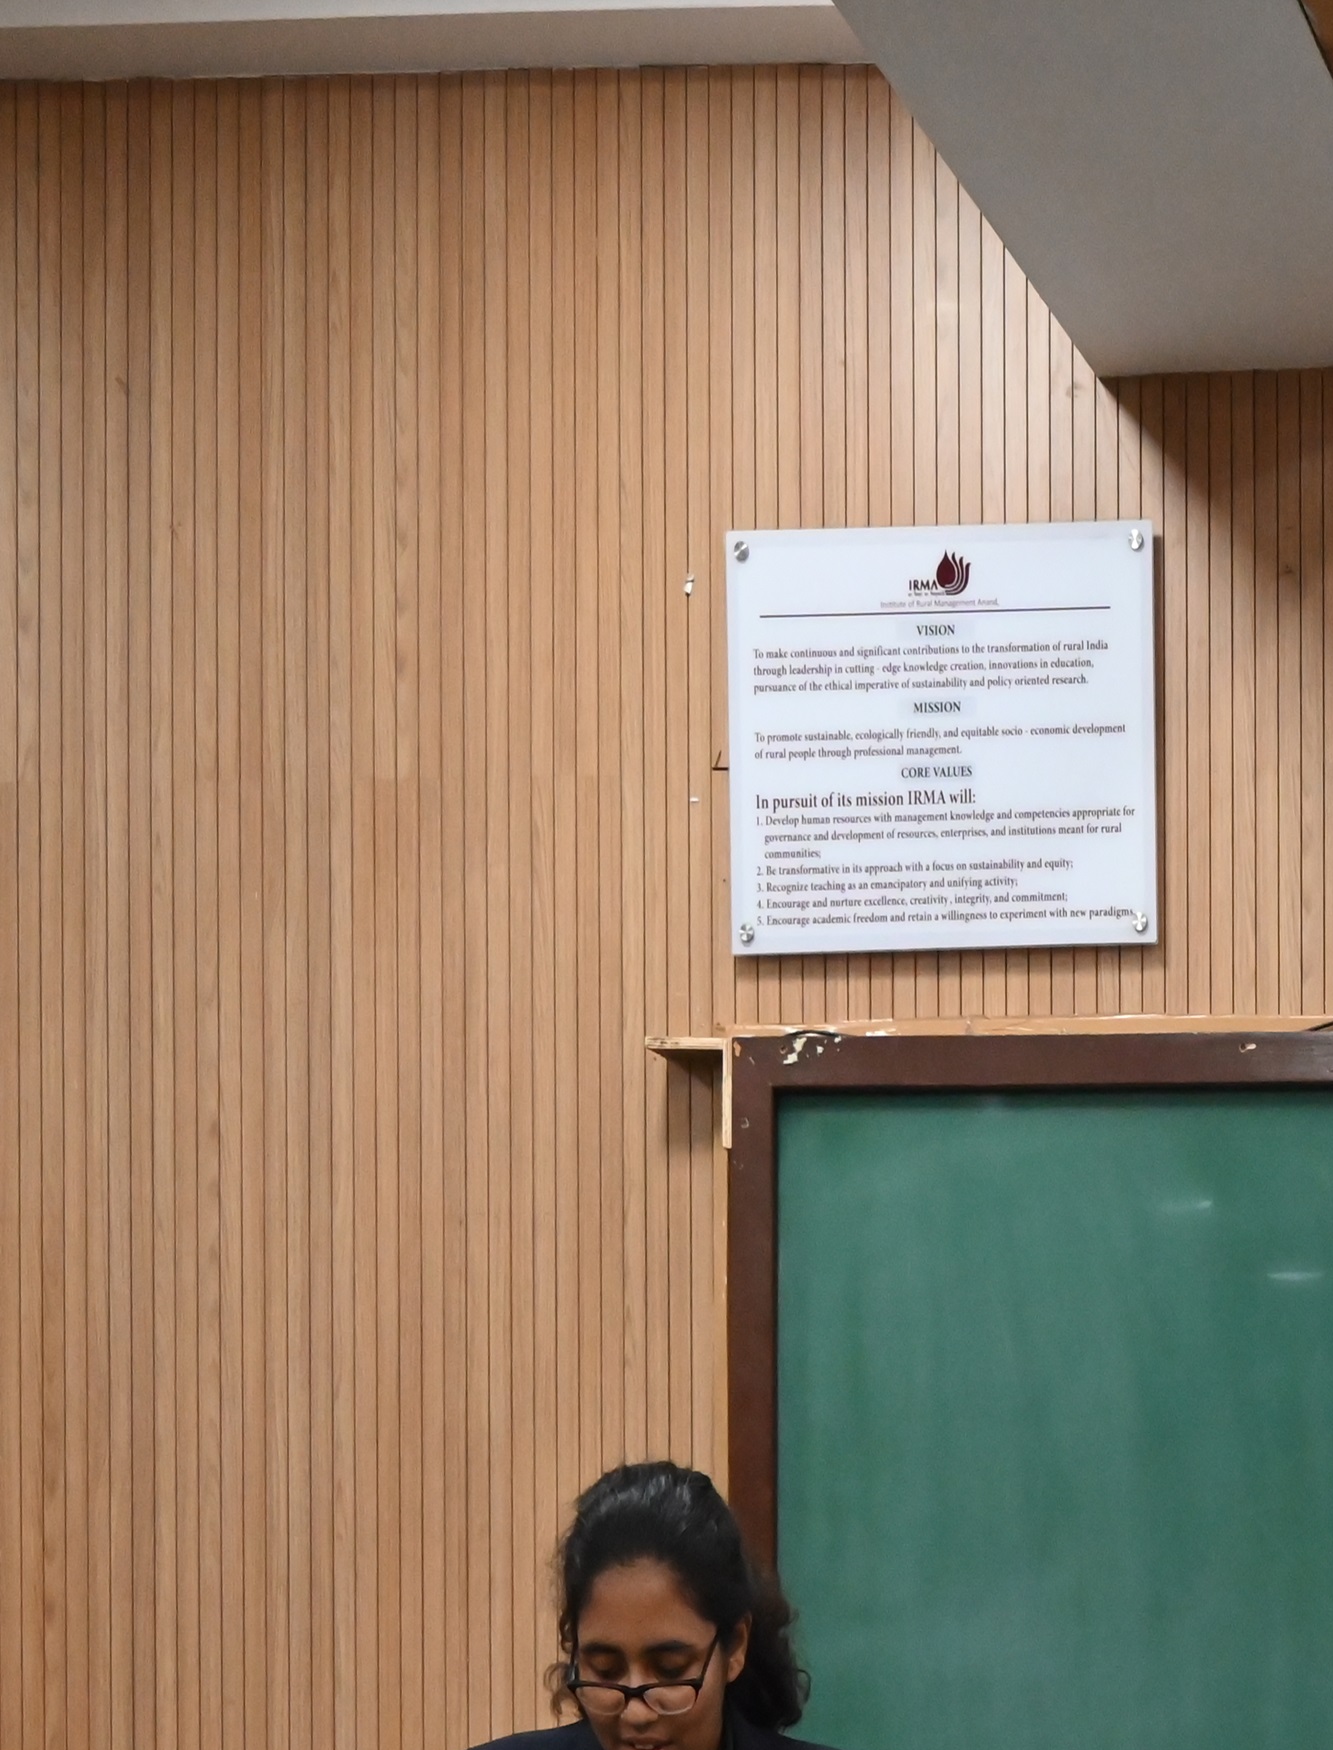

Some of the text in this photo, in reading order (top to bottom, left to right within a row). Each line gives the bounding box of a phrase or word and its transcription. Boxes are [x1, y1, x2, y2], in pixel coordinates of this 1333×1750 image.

[909, 580, 938, 591] IRMA
[916, 624, 954, 636] VISION
[753, 639, 1108, 659] To make continuous and significant contributions to the transformation of rural India
[753, 684, 796, 695] pursuance
[798, 681, 807, 690] of
[809, 681, 822, 690] the
[824, 679, 852, 690] ethical
[854, 679, 898, 692] imperative
[901, 678, 909, 688] of
[911, 676, 966, 689] sustainability
[969, 676, 984, 686] and
[987, 675, 1011, 689] policy
[1014, 674, 1049, 685] oriented
[914, 701, 961, 713] MISSION
[755, 732, 765, 742] To
[767, 733, 802, 745] promote
[855, 728, 902, 742] ecologically
[943, 727, 958, 737] and
[961, 726, 998, 739] equitable
[1001, 726, 1022, 735] socio
[1030, 725, 1069, 735] economic
[1072, 722, 1125, 736] development
[754, 749, 763, 758] of
[765, 748, 786, 758] rural
[788, 747, 815, 761] people
[818, 746, 851, 760] through
[854, 745, 903, 759] professional
[901, 765, 972, 778] CORE VALUES
[756, 794, 768, 809] In
[772, 793, 817, 812] pursuit
[820, 791, 834, 807] of
[837, 792, 851, 807] its
[855, 791, 903, 806] mission
[908, 789, 945, 805] IRMA
[765, 812, 799, 828] Develop
[801, 813, 830, 824] human
[873, 812, 891, 822] with
[894, 812, 947, 825] management
[950, 809, 994, 823] knowledge
[996, 808, 1012, 819] and
[1014, 807, 1070, 821] competencies
[1072, 806, 1120, 820] appropriate
[1123, 805, 1135, 815] for
[766, 865, 776, 875] Be
[778, 863, 839, 874] transformative
[842, 864, 850, 873] in
[852, 863, 862, 872] its
[864, 862, 902, 875] approach
[905, 861, 923, 871] with
[932, 860, 953, 871] focus
[969, 858, 1024, 872] sustainability
[1026, 858, 1042, 868] and
[766, 897, 809, 911] Encourage
[812, 897, 827, 907] and
[830, 898, 861, 906] nurture
[994, 891, 1009, 902] and
[767, 914, 809, 928] Encourage
[812, 913, 850, 924] academic
[853, 912, 887, 923] freedom
[890, 911, 905, 921] and
[908, 911, 932, 921] retain
[941, 909, 987, 923] willingness
[989, 911, 997, 919] to
[999, 908, 1046, 922] experiment
[1049, 907, 1067, 917] with
